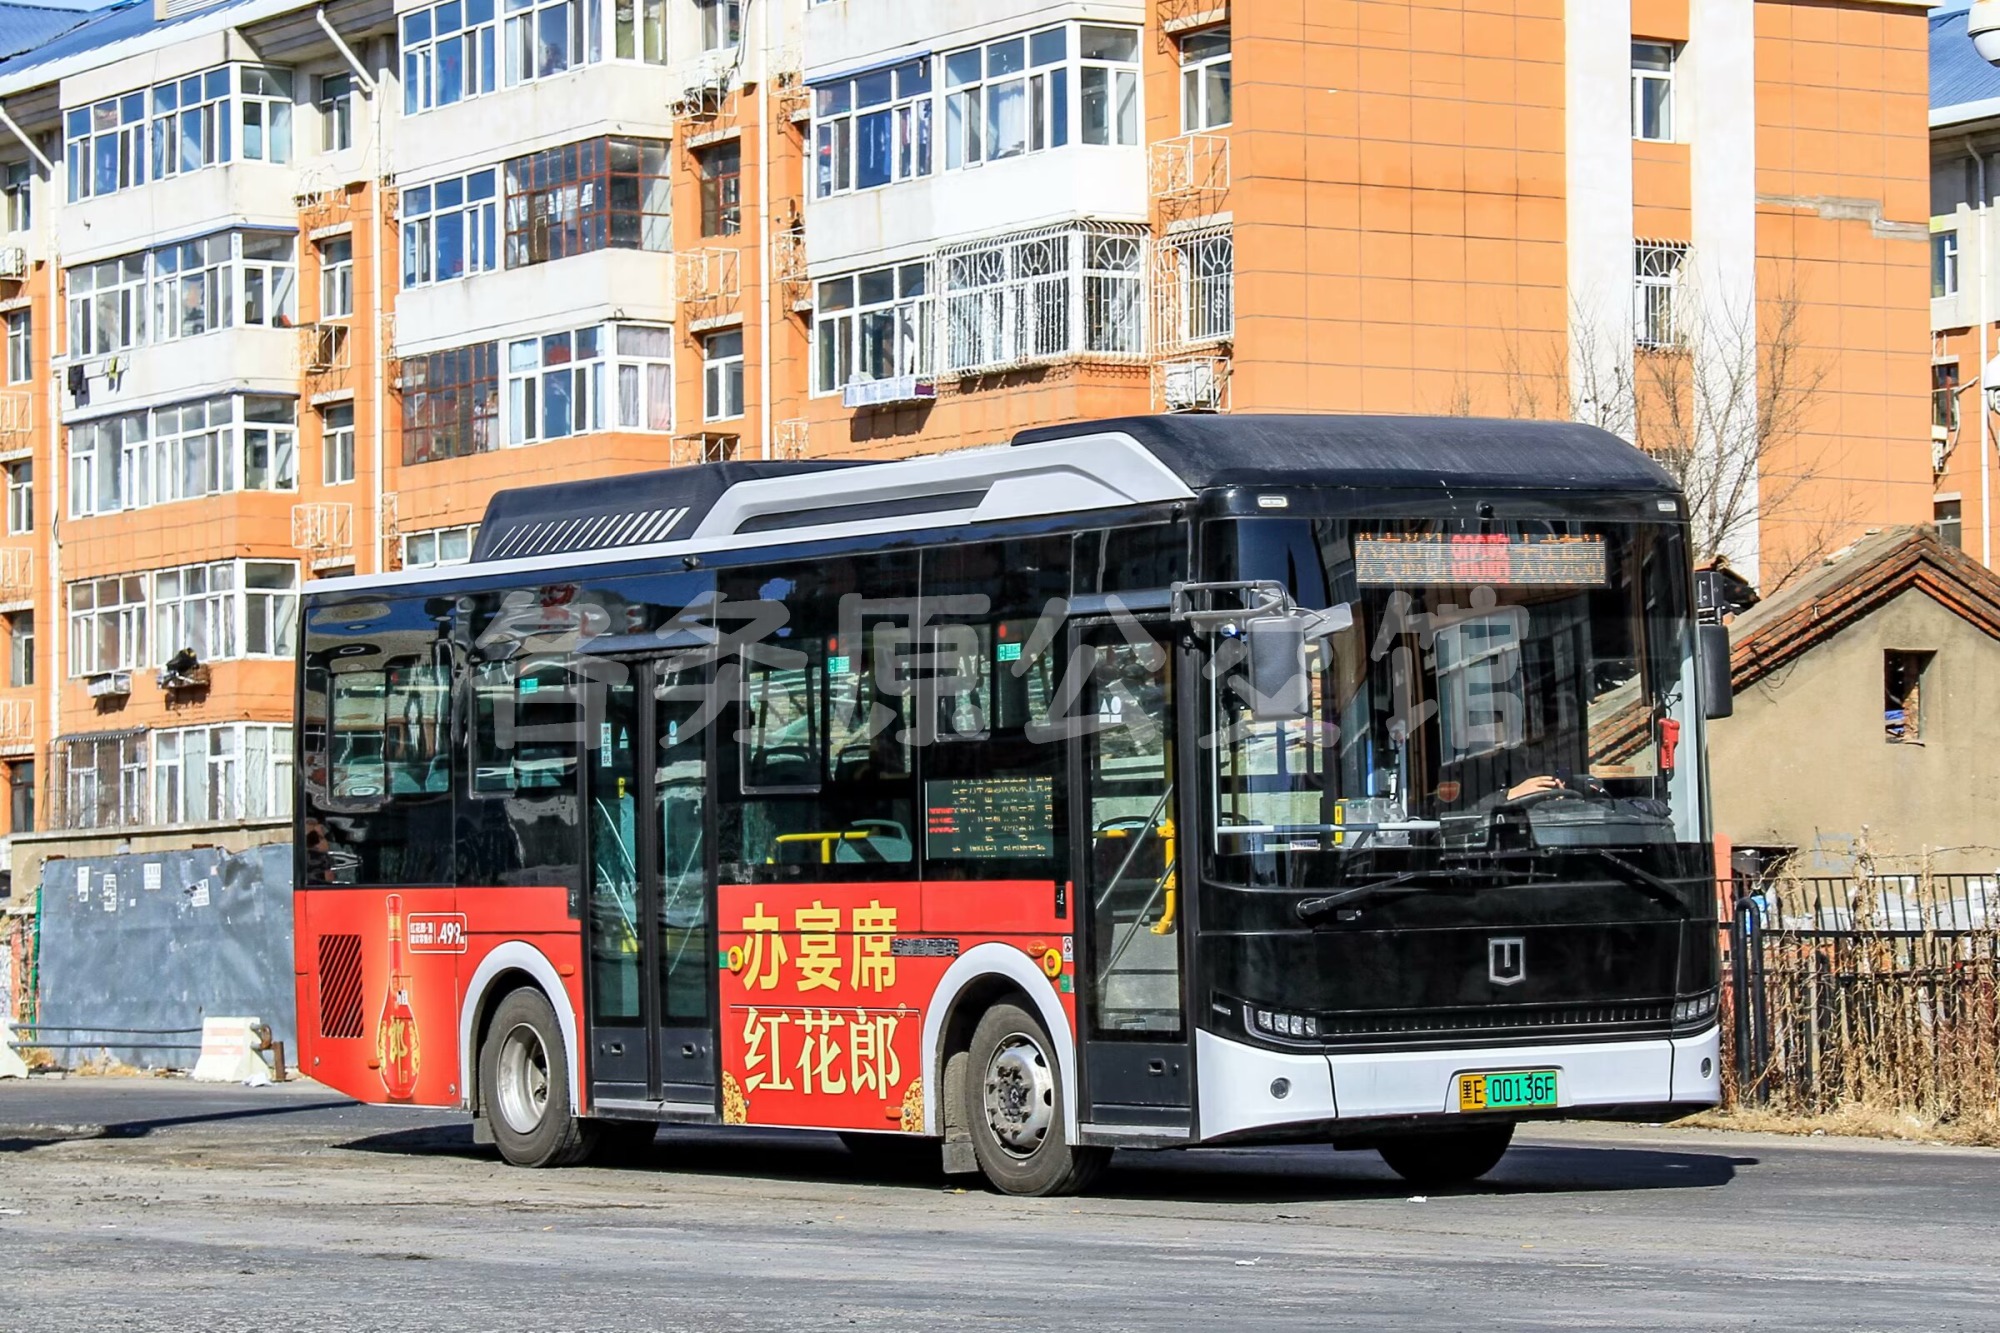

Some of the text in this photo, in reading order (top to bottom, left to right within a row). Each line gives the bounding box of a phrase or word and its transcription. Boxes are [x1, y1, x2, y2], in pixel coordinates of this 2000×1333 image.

[741, 900, 897, 992] 办宴席
[742, 1004, 900, 1100] 红花郎
